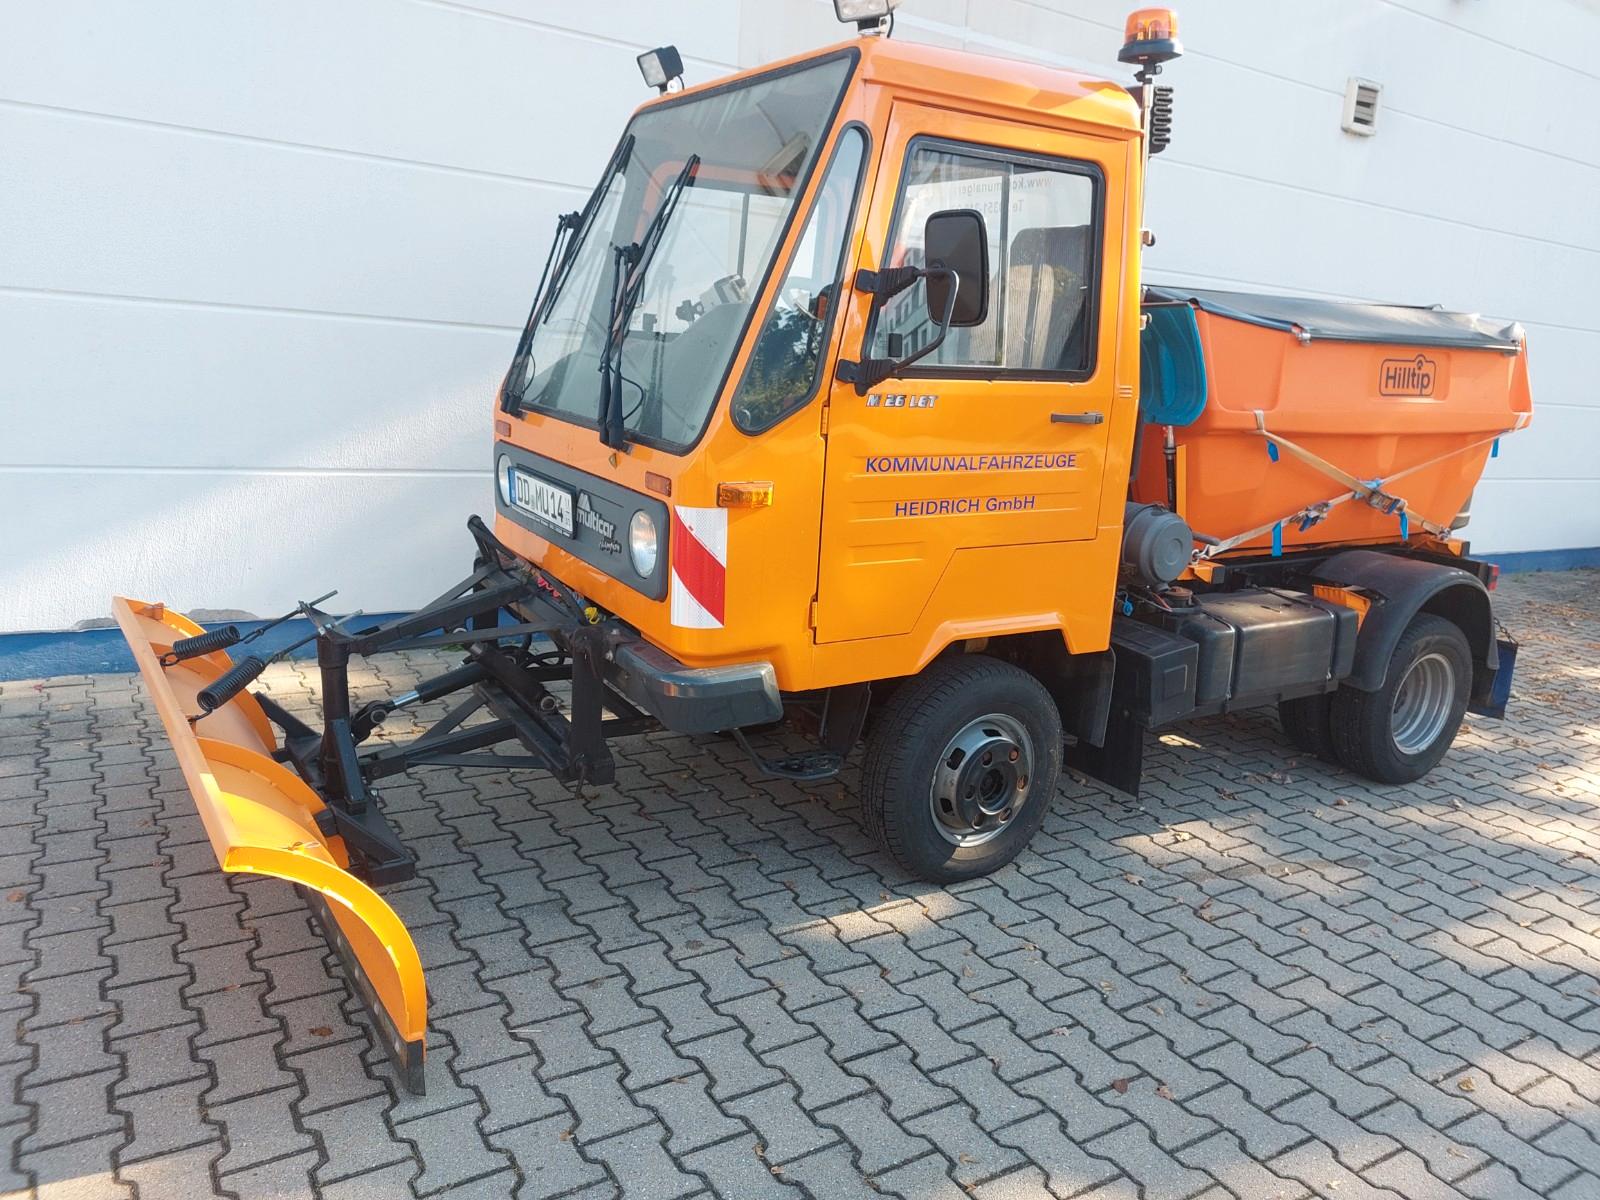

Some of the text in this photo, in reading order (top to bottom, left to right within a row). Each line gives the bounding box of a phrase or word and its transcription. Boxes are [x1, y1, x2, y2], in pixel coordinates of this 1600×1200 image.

[1385, 366, 1431, 396] Hilltip
[866, 394, 882, 407] M
[884, 394, 907, 408] 26
[866, 454, 1077, 473] KOMMUNALFAHRZEUGE
[517, 475, 530, 505] DD
[895, 495, 1036, 517] HEIDRICH GmbH
[576, 508, 614, 538] multicar
